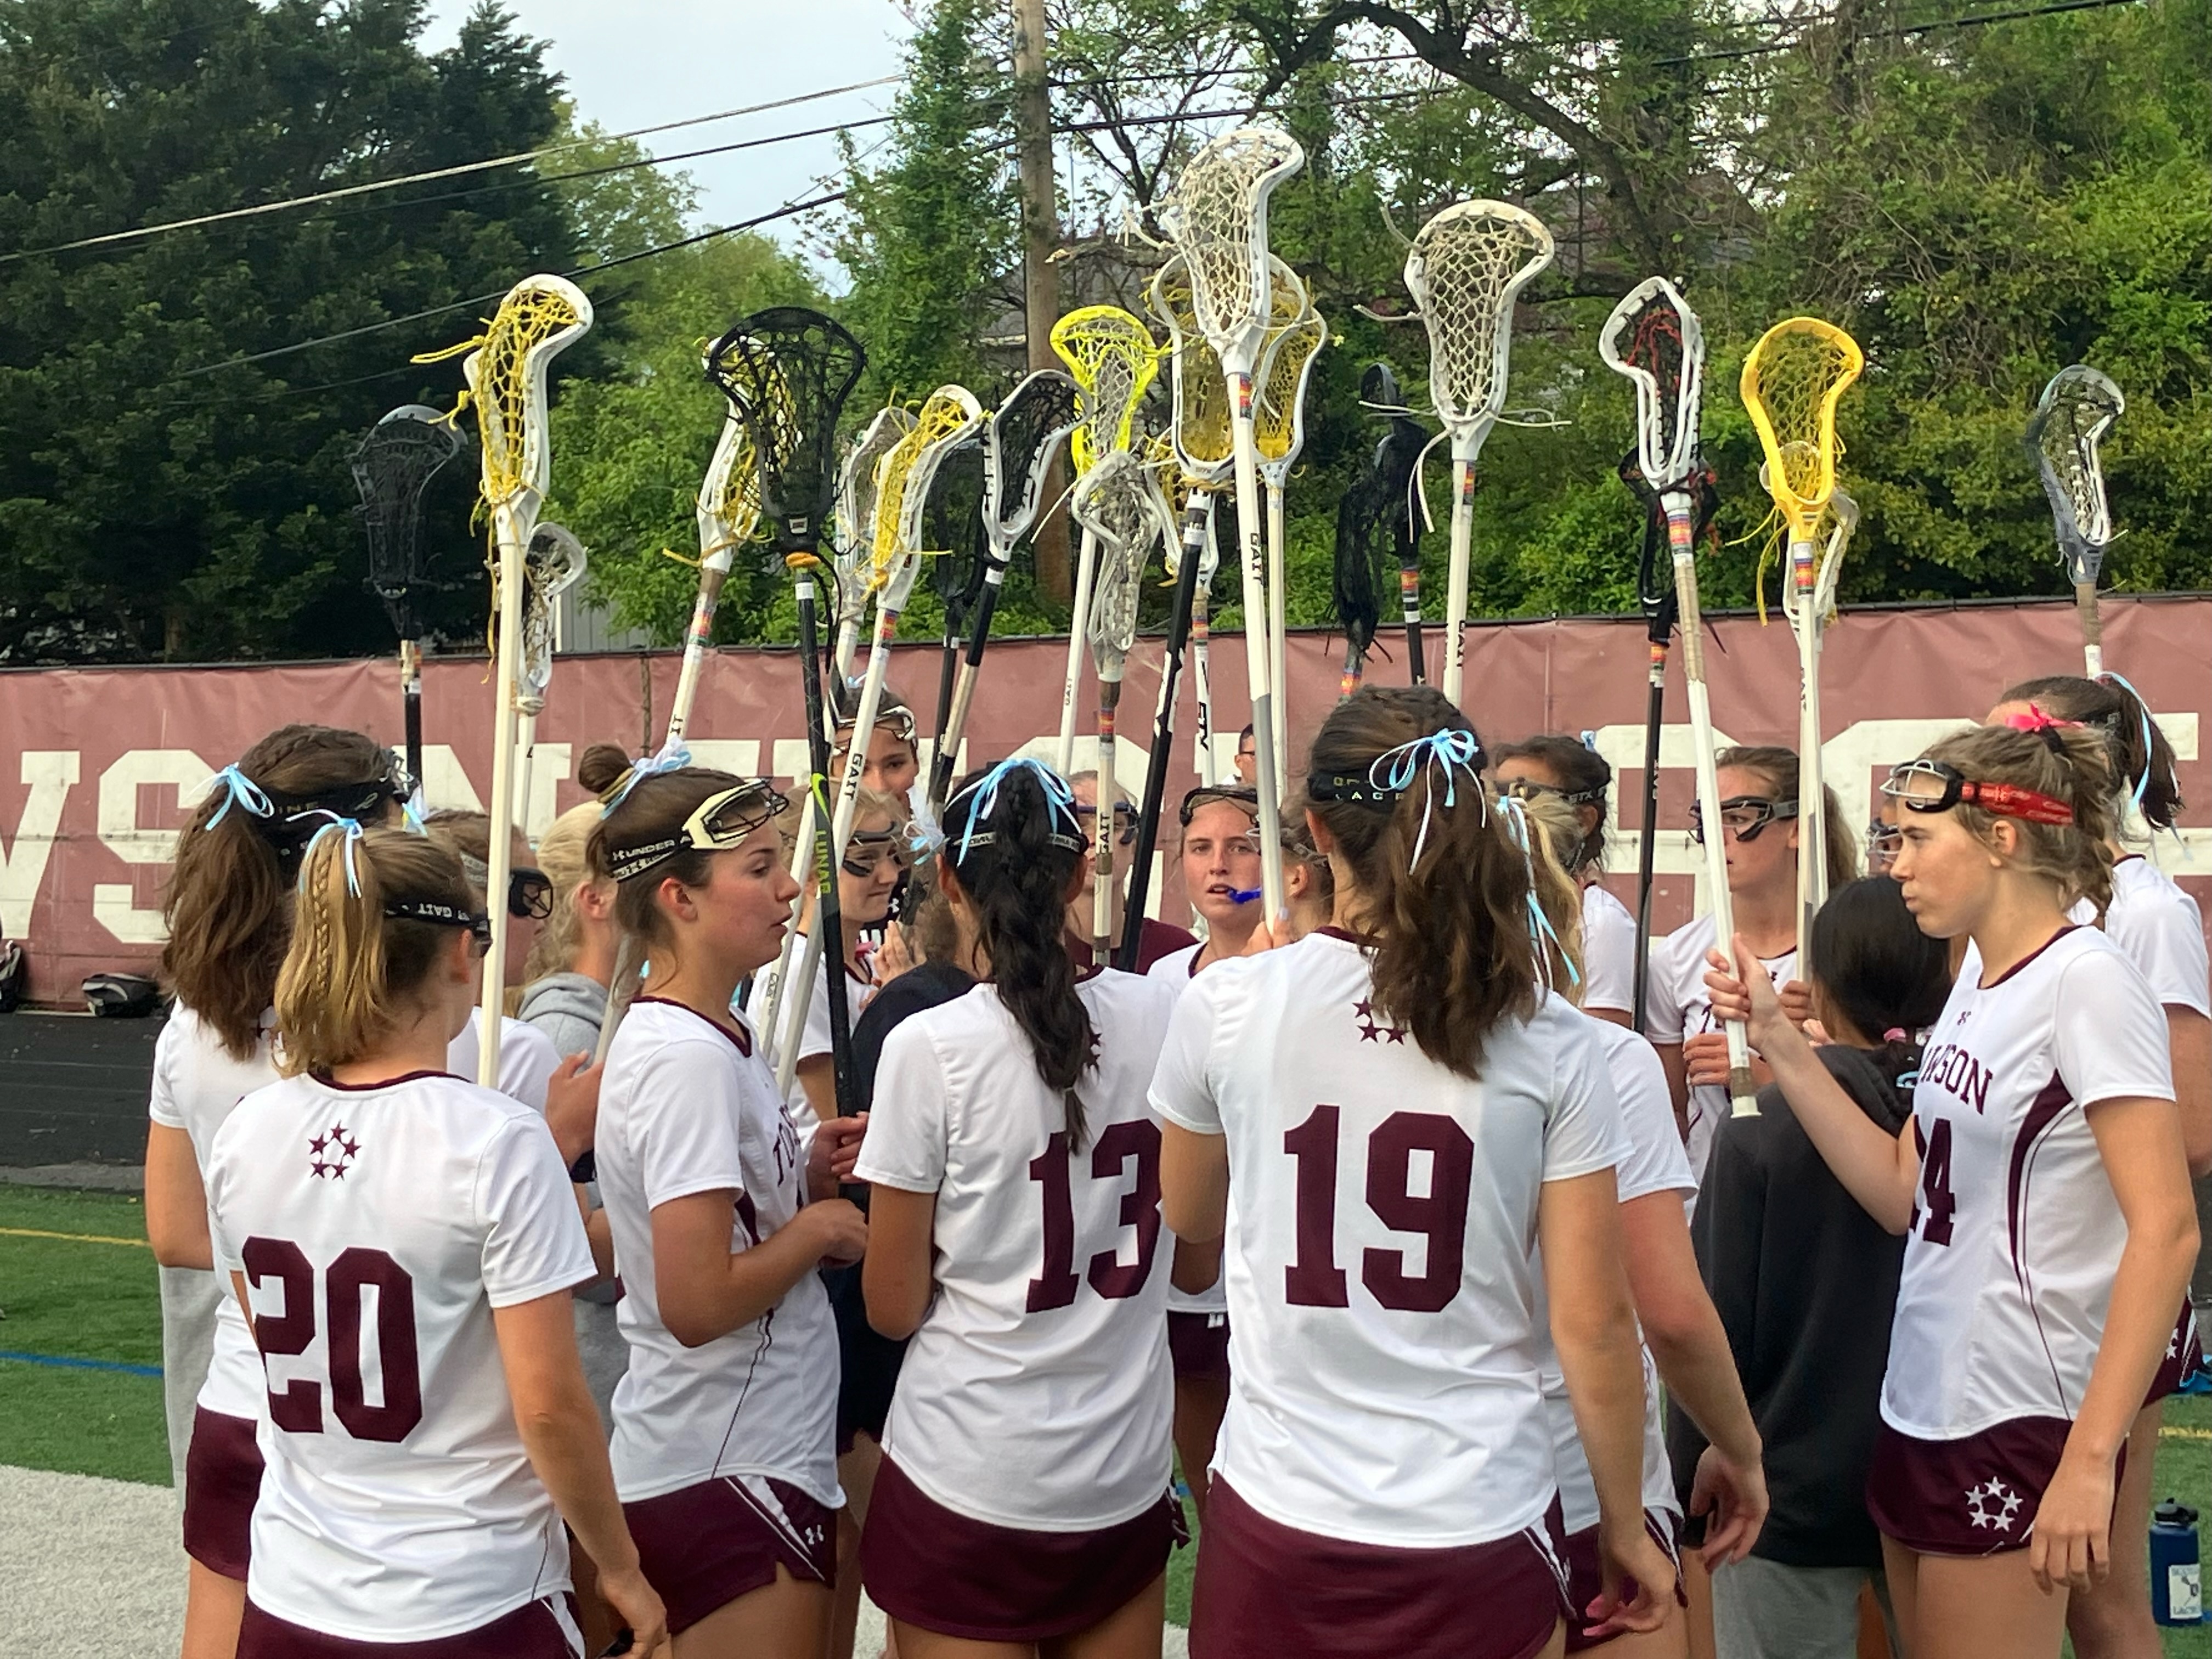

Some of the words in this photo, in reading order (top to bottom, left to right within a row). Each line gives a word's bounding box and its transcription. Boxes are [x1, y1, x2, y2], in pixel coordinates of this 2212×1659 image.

[844, 752, 864, 801] GAIT
[625, 839, 676, 857] UNDER
[814, 829, 831, 894] LUNAR
[1099, 812, 1110, 854] GAIT
[417, 902, 453, 918] GAIT
[1025, 1118, 1162, 1313] 13
[1284, 1104, 1475, 1312] 19
[241, 1235, 423, 1444] 20
